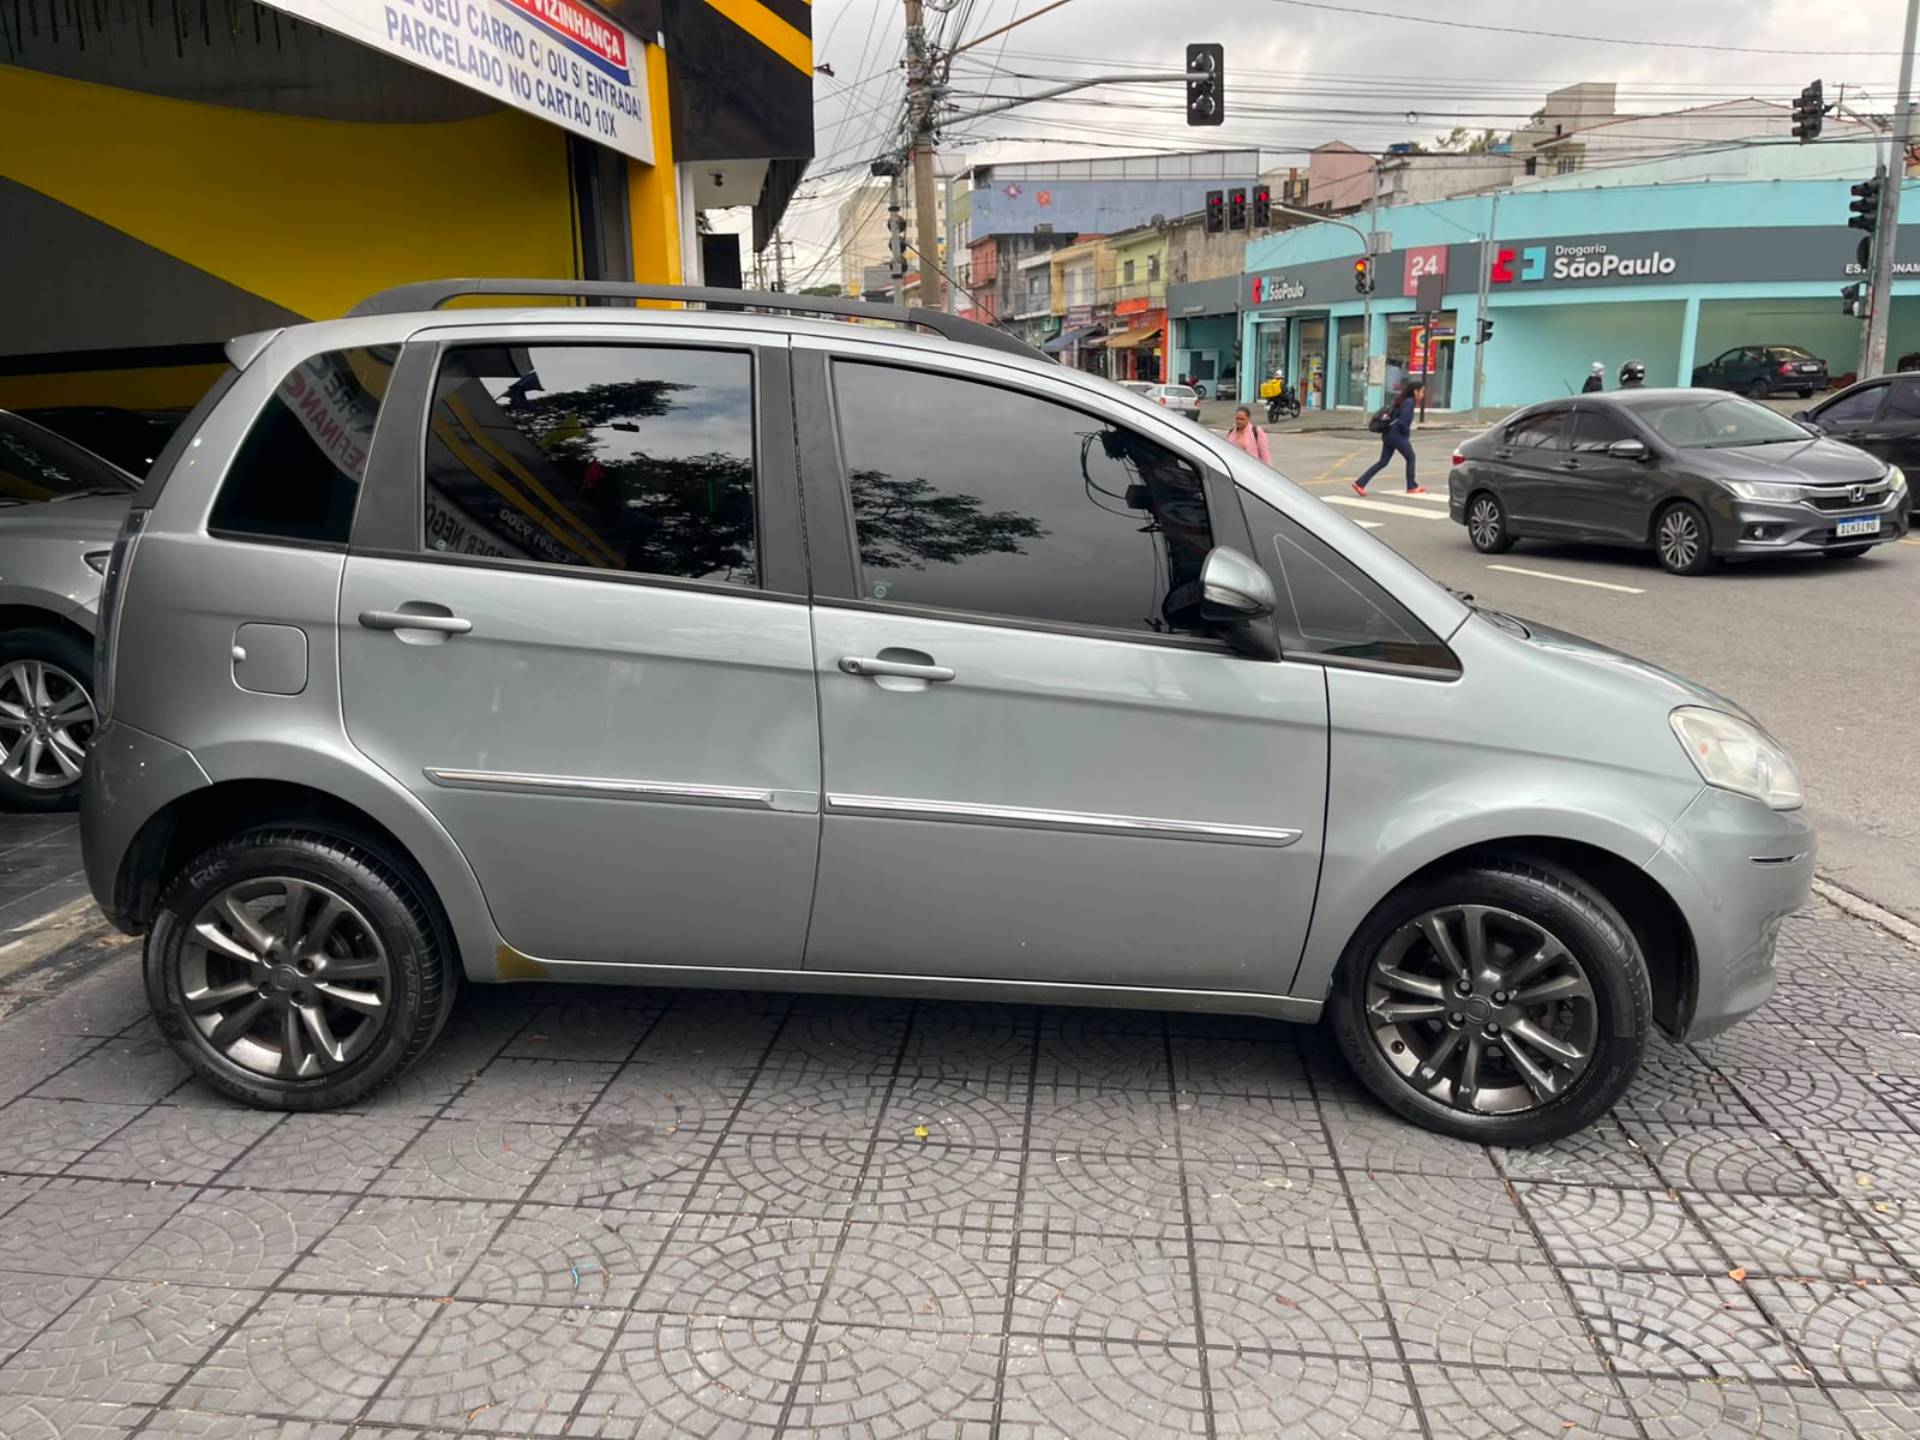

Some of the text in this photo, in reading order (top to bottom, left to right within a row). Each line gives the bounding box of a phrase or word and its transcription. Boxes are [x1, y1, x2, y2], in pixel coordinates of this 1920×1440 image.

[385, 5, 503, 86] PARCELADO
[508, 63, 531, 101] NO
[595, 107, 617, 138] 10X
[466, 3, 524, 58] CARRO
[548, 49, 567, 82] OU
[586, 70, 643, 122] ENTRADA!
[1411, 255, 1438, 276] 24
[1555, 244, 1607, 257] Drogaria
